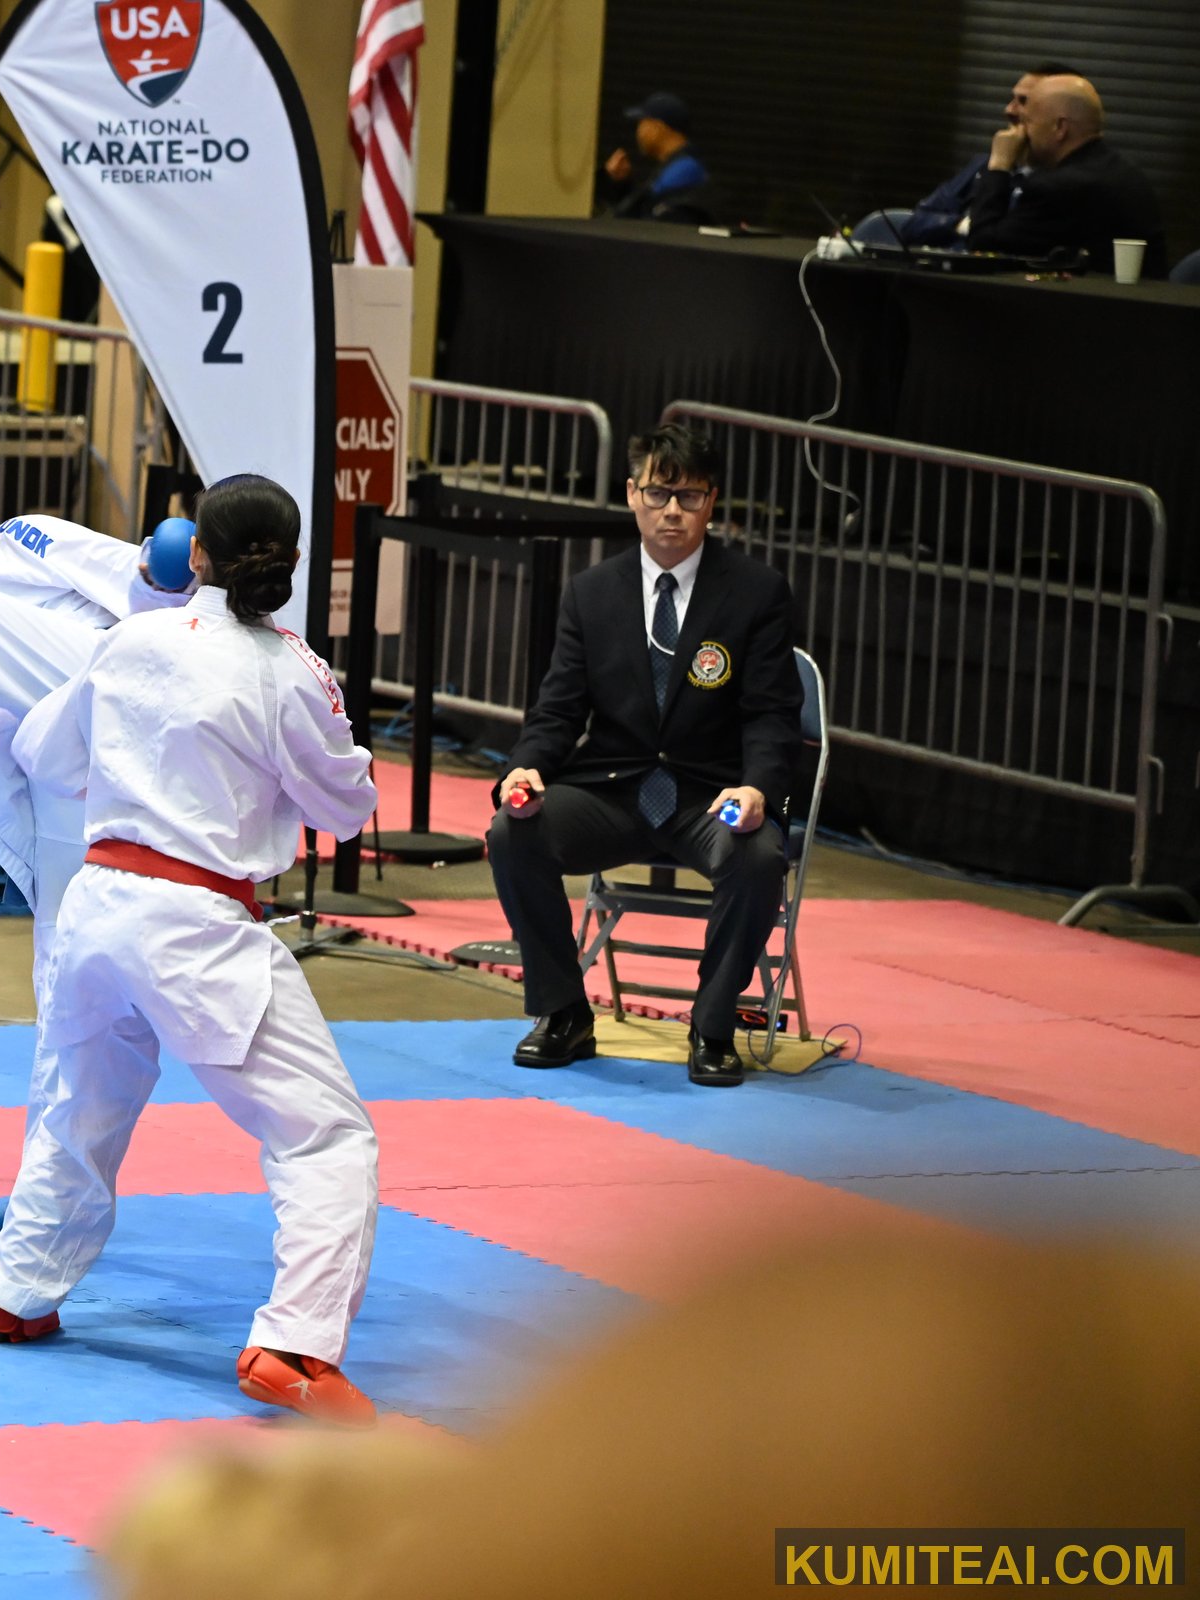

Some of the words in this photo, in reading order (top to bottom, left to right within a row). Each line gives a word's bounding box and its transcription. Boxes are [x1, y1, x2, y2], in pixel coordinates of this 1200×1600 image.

[110, 6, 190, 39] USA
[98, 119, 210, 136] NATIONAL
[62, 138, 250, 165] KARATE-DO
[101, 169, 213, 184] FEDERATION
[202, 281, 243, 364] 2
[336, 417, 394, 451] CIALS
